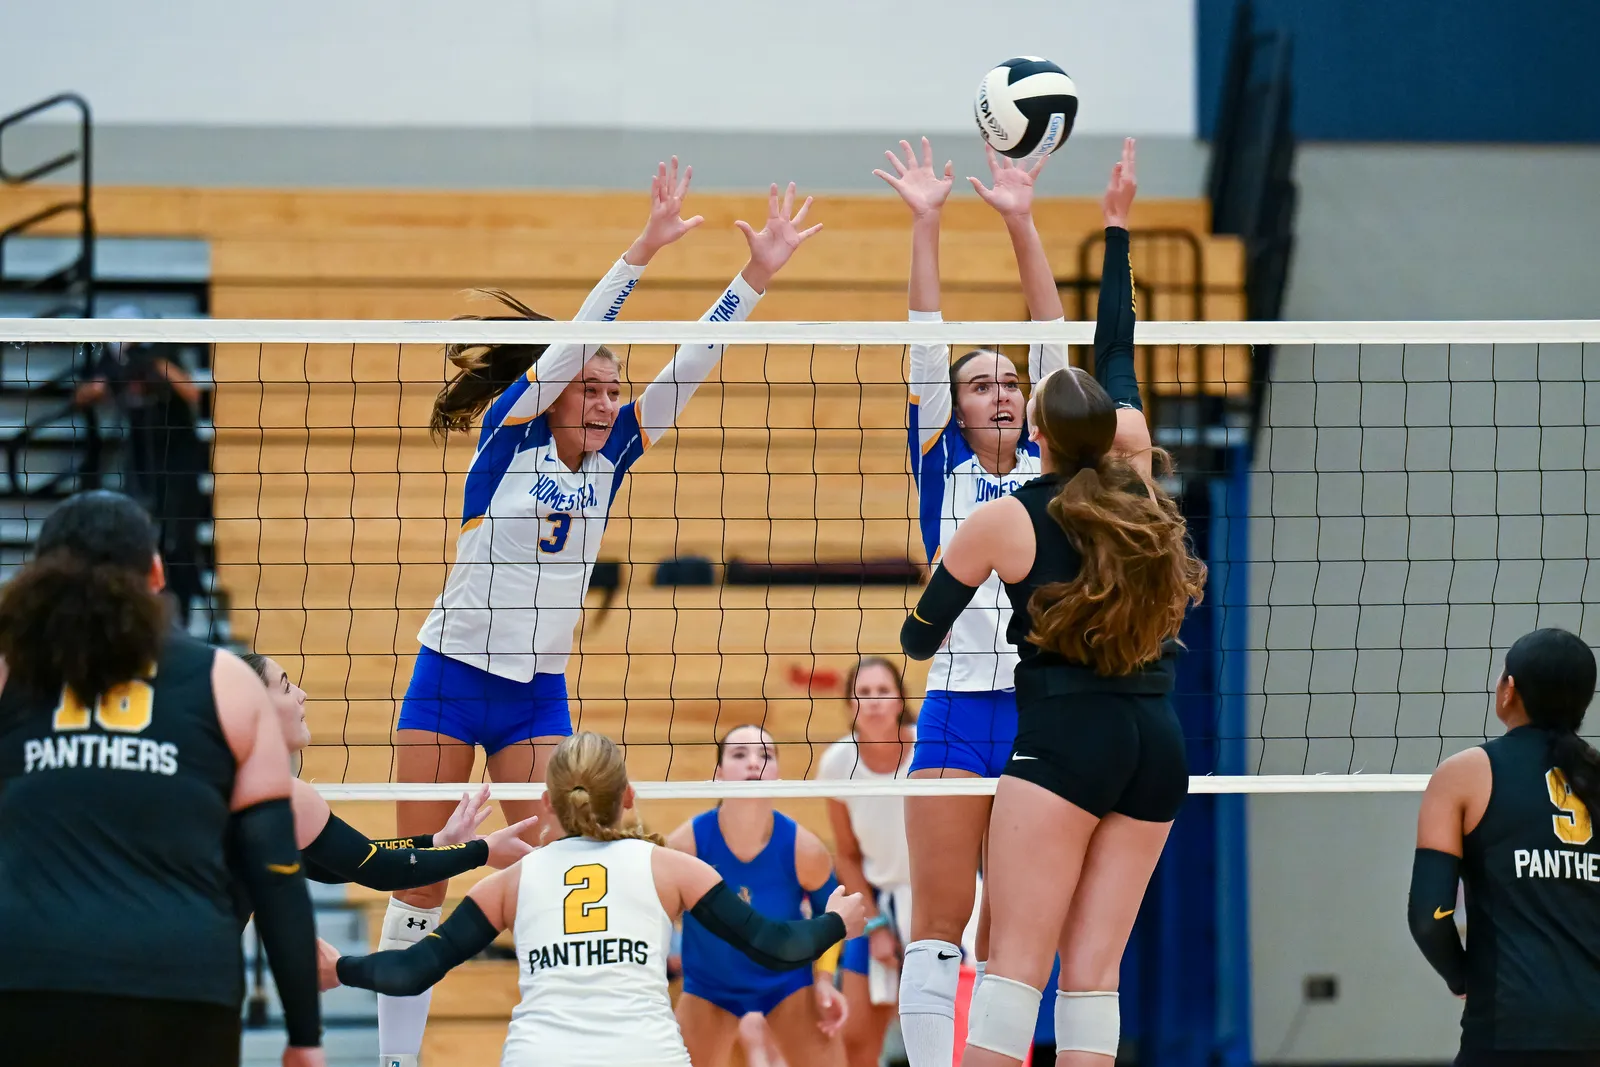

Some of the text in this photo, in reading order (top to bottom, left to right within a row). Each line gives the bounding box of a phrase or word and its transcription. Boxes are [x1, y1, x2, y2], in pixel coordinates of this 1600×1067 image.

[601, 278, 639, 322] SPARTAN
[528, 473, 598, 512] HOMESTEA
[538, 512, 572, 554] 3
[24, 735, 179, 776] PANTHERS
[1513, 848, 1600, 883] PANTHE
[563, 862, 608, 935] 2
[528, 938, 649, 975] PANTHERS
